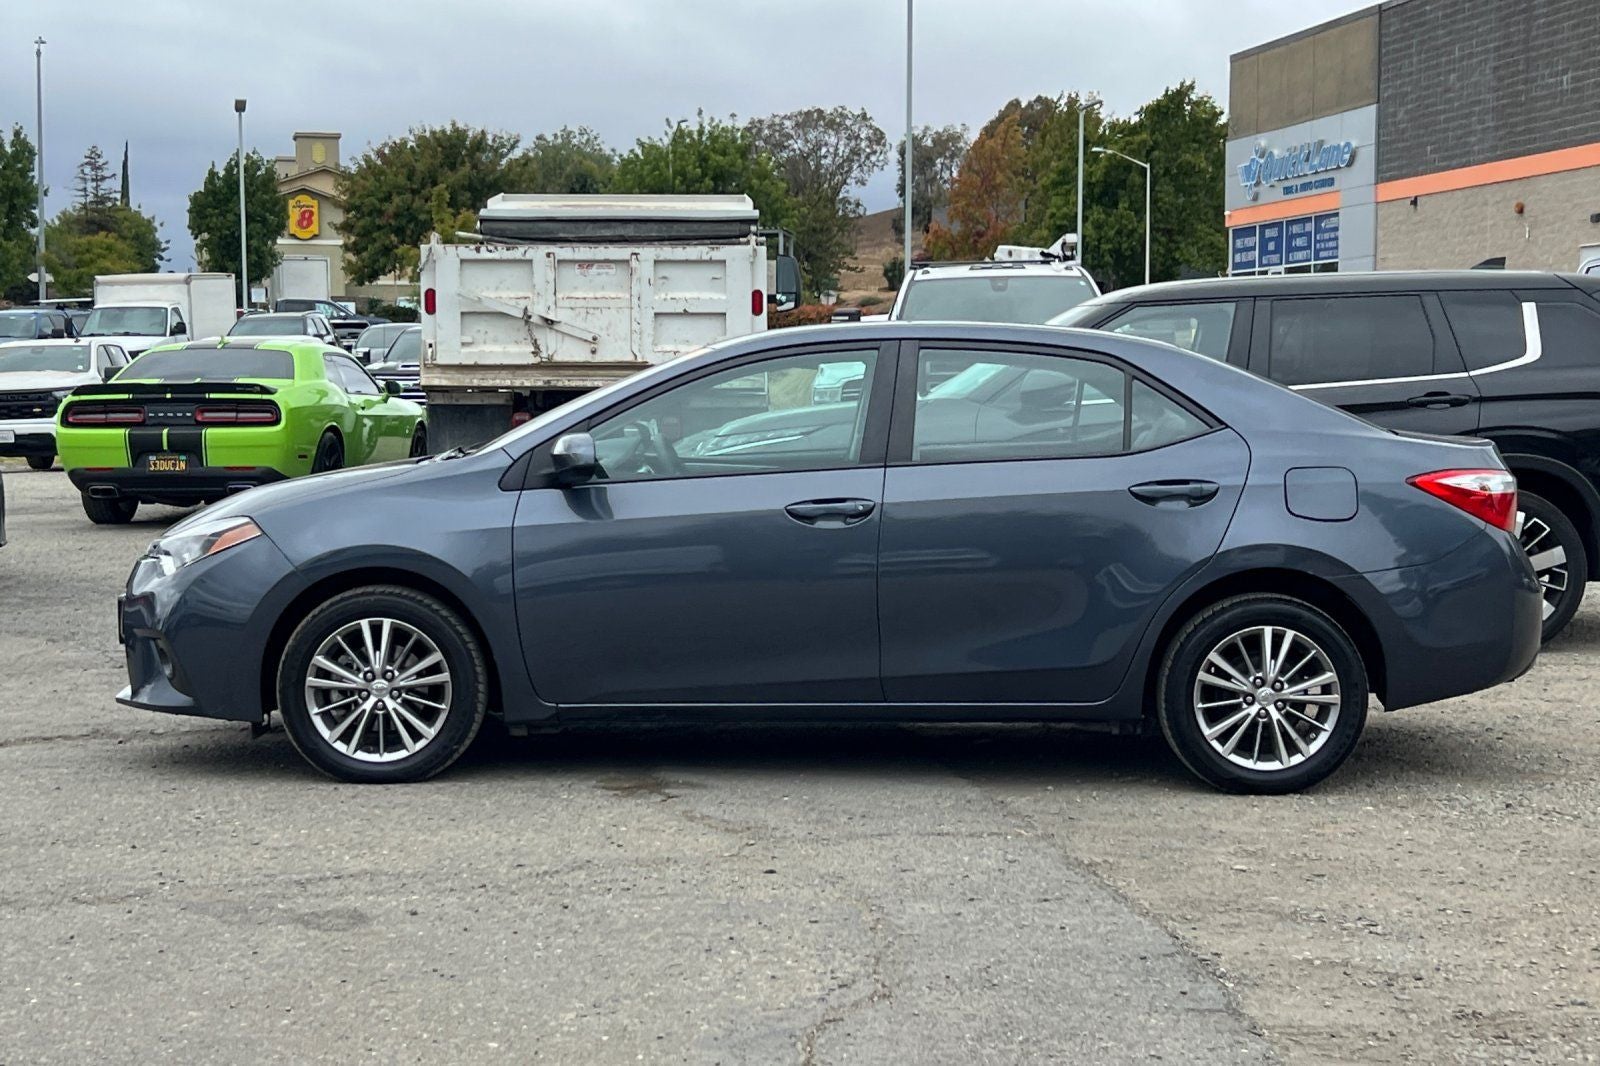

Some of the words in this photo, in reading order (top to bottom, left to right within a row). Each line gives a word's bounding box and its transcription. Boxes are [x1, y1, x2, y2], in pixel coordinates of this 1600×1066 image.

[1261, 144, 1309, 185] Quick
[1308, 140, 1354, 173] Lane
[297, 209, 315, 229] 8
